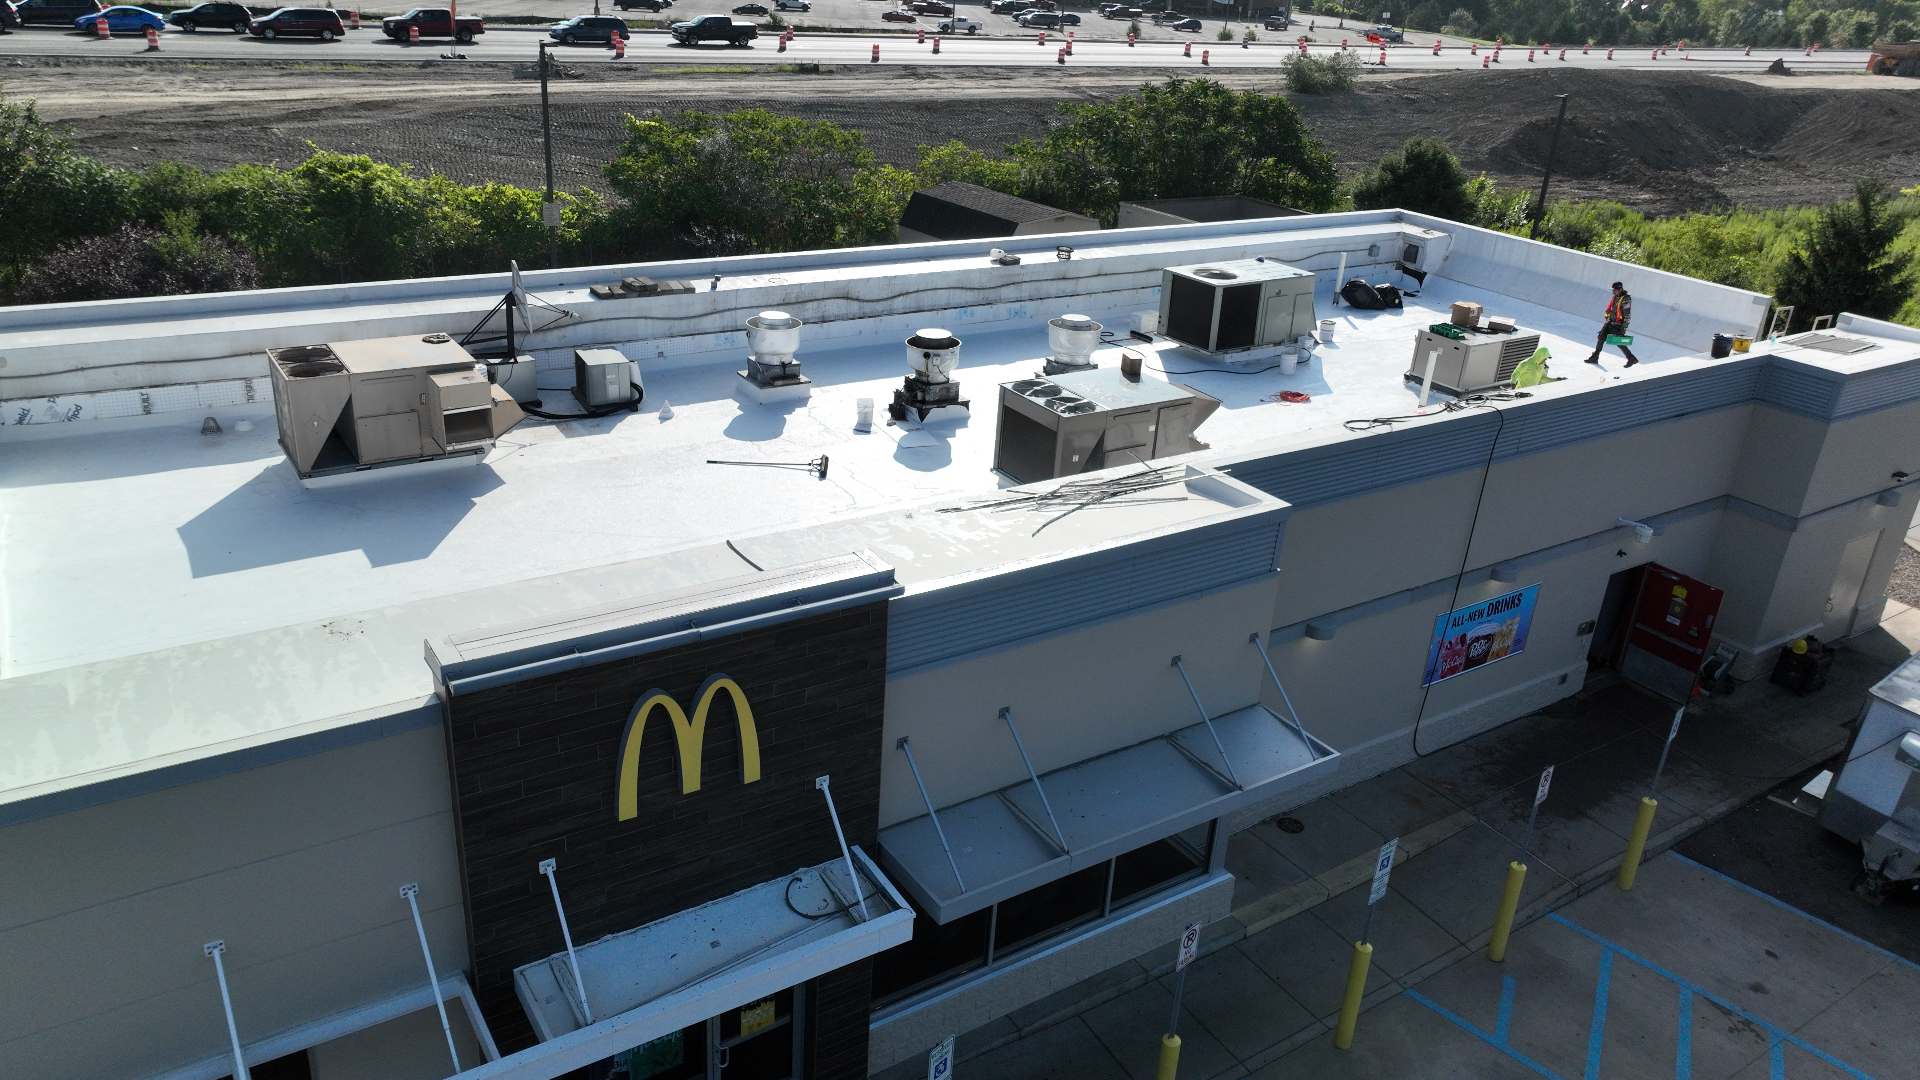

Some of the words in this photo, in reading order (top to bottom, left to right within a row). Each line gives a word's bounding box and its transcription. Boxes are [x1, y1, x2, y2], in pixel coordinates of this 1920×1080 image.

[1451, 608, 1486, 629] ALL-NEW
[1486, 592, 1523, 618] DRINKS
[616, 673, 761, 822] M
